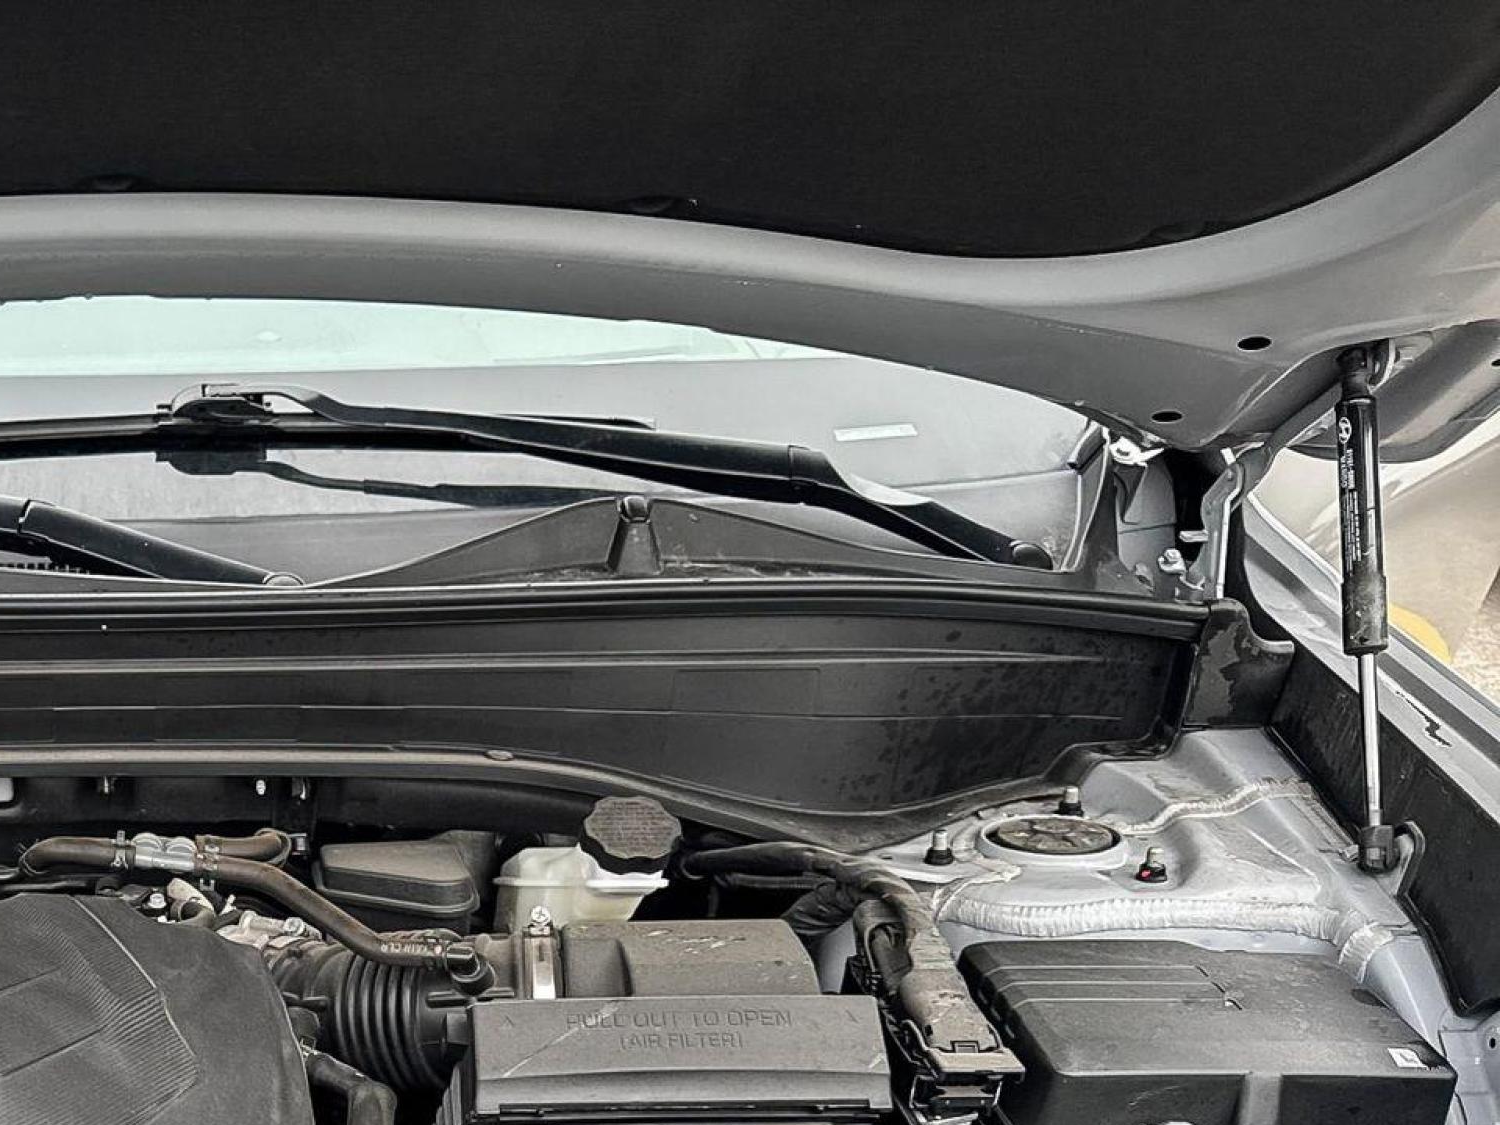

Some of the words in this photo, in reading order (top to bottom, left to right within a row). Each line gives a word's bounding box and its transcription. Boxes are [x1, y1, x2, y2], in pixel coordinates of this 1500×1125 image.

[566, 1011, 626, 1029] PULL
[633, 1011, 678, 1028] OUT
[692, 1010, 720, 1027] TO
[727, 1010, 792, 1027] OPEN
